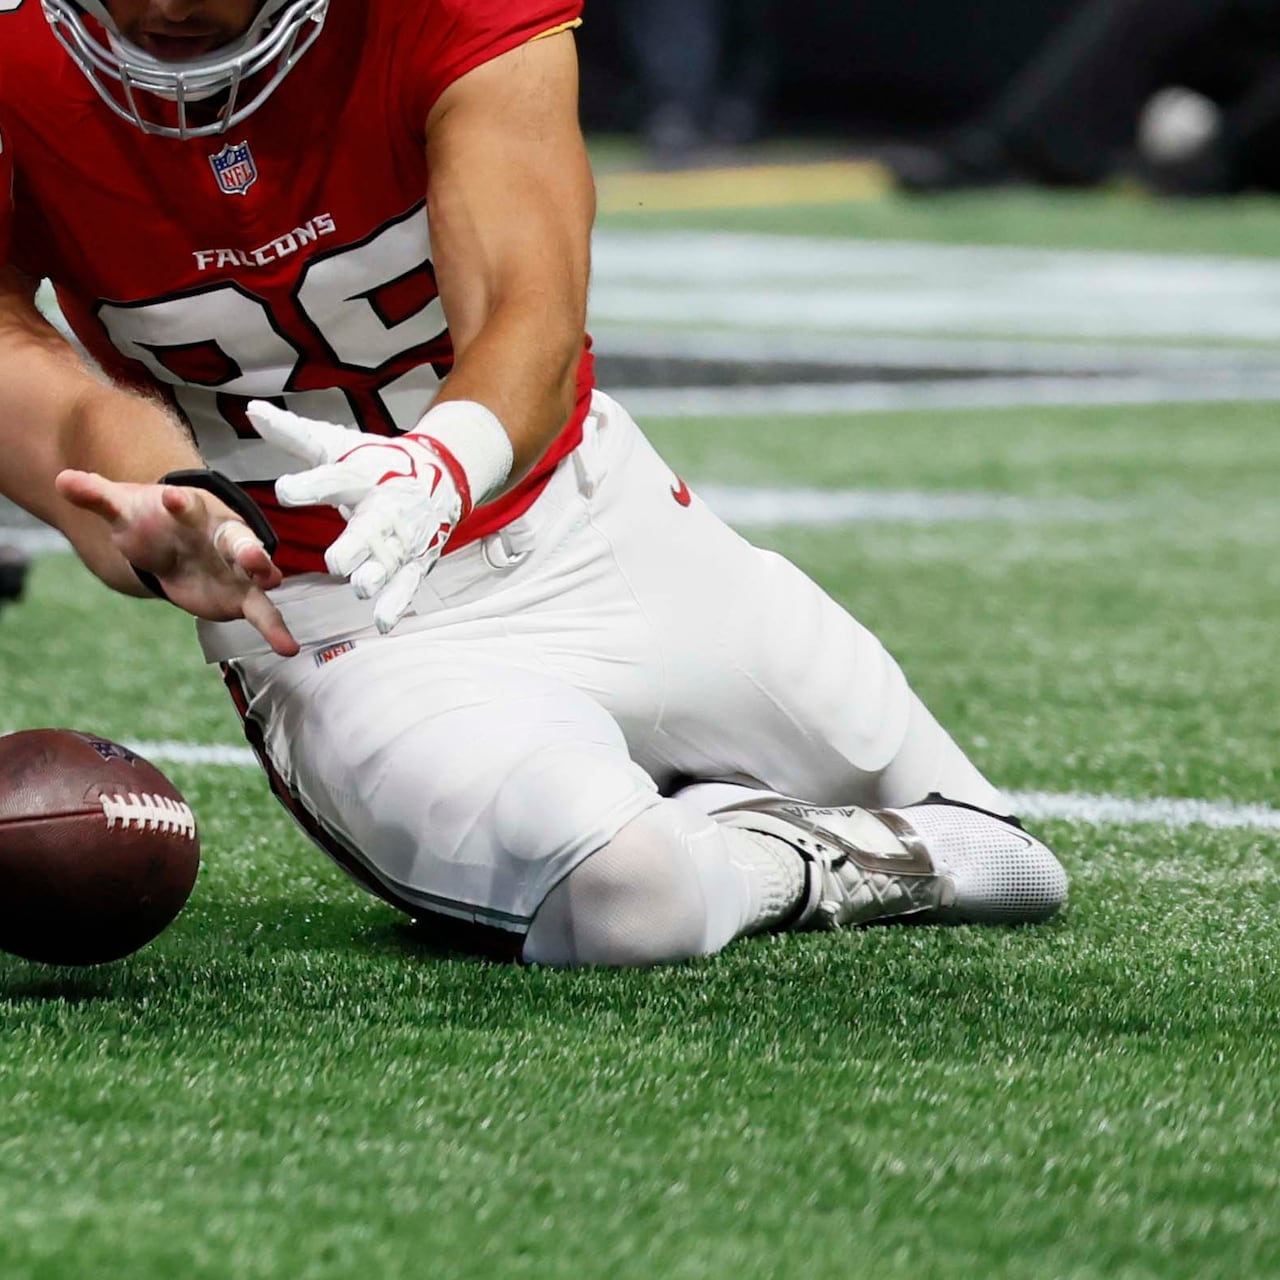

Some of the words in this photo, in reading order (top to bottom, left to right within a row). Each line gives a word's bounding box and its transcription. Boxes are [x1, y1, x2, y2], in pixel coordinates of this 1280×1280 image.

[221, 162, 252, 187] NFL
[192, 213, 337, 271] FALCONS
[95, 196, 455, 486] 89
